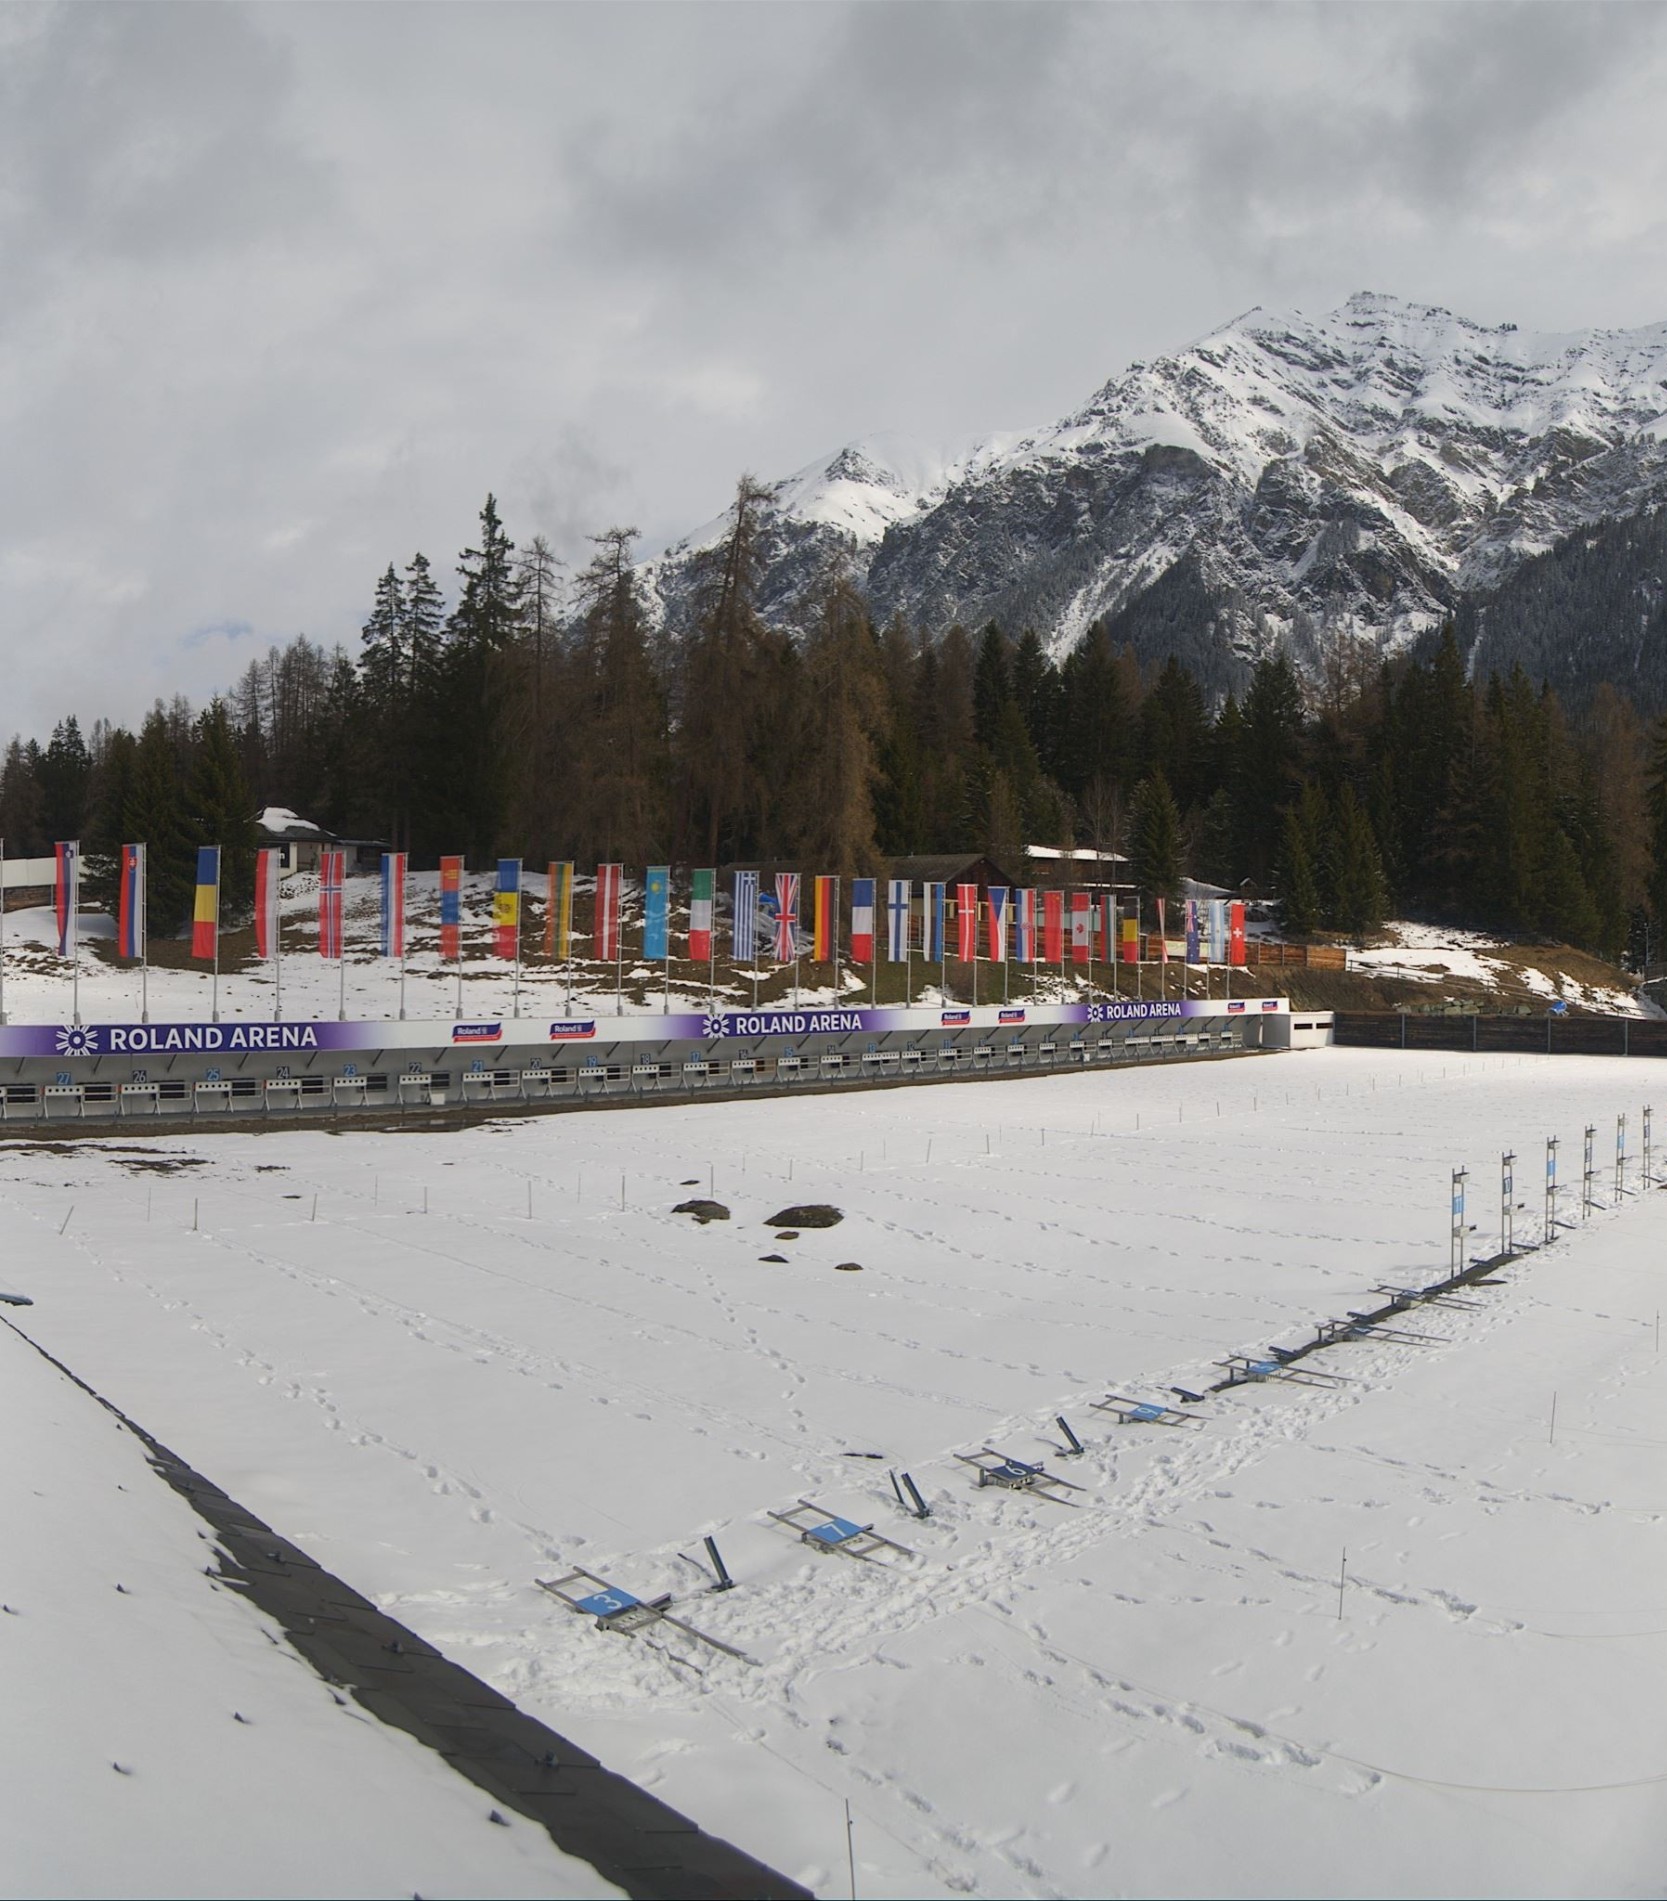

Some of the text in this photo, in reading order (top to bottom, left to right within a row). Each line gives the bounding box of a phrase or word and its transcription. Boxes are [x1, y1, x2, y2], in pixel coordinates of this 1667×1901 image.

[1106, 1002, 1181, 1019] ROLAND ARENA
[735, 1013, 862, 1035] ROLAND ARENA
[457, 1027, 479, 1035] Roland
[110, 1026, 318, 1051] ROLAND ARENA
[277, 1067, 289, 1079] 24
[345, 1065, 356, 1076] 23
[410, 1062, 421, 1073] 22
[57, 1073, 70, 1085] 27
[134, 1071, 146, 1083] 26
[207, 1069, 220, 1081] 25
[821, 1523, 847, 1538] 7
[593, 1594, 622, 1609] 3
